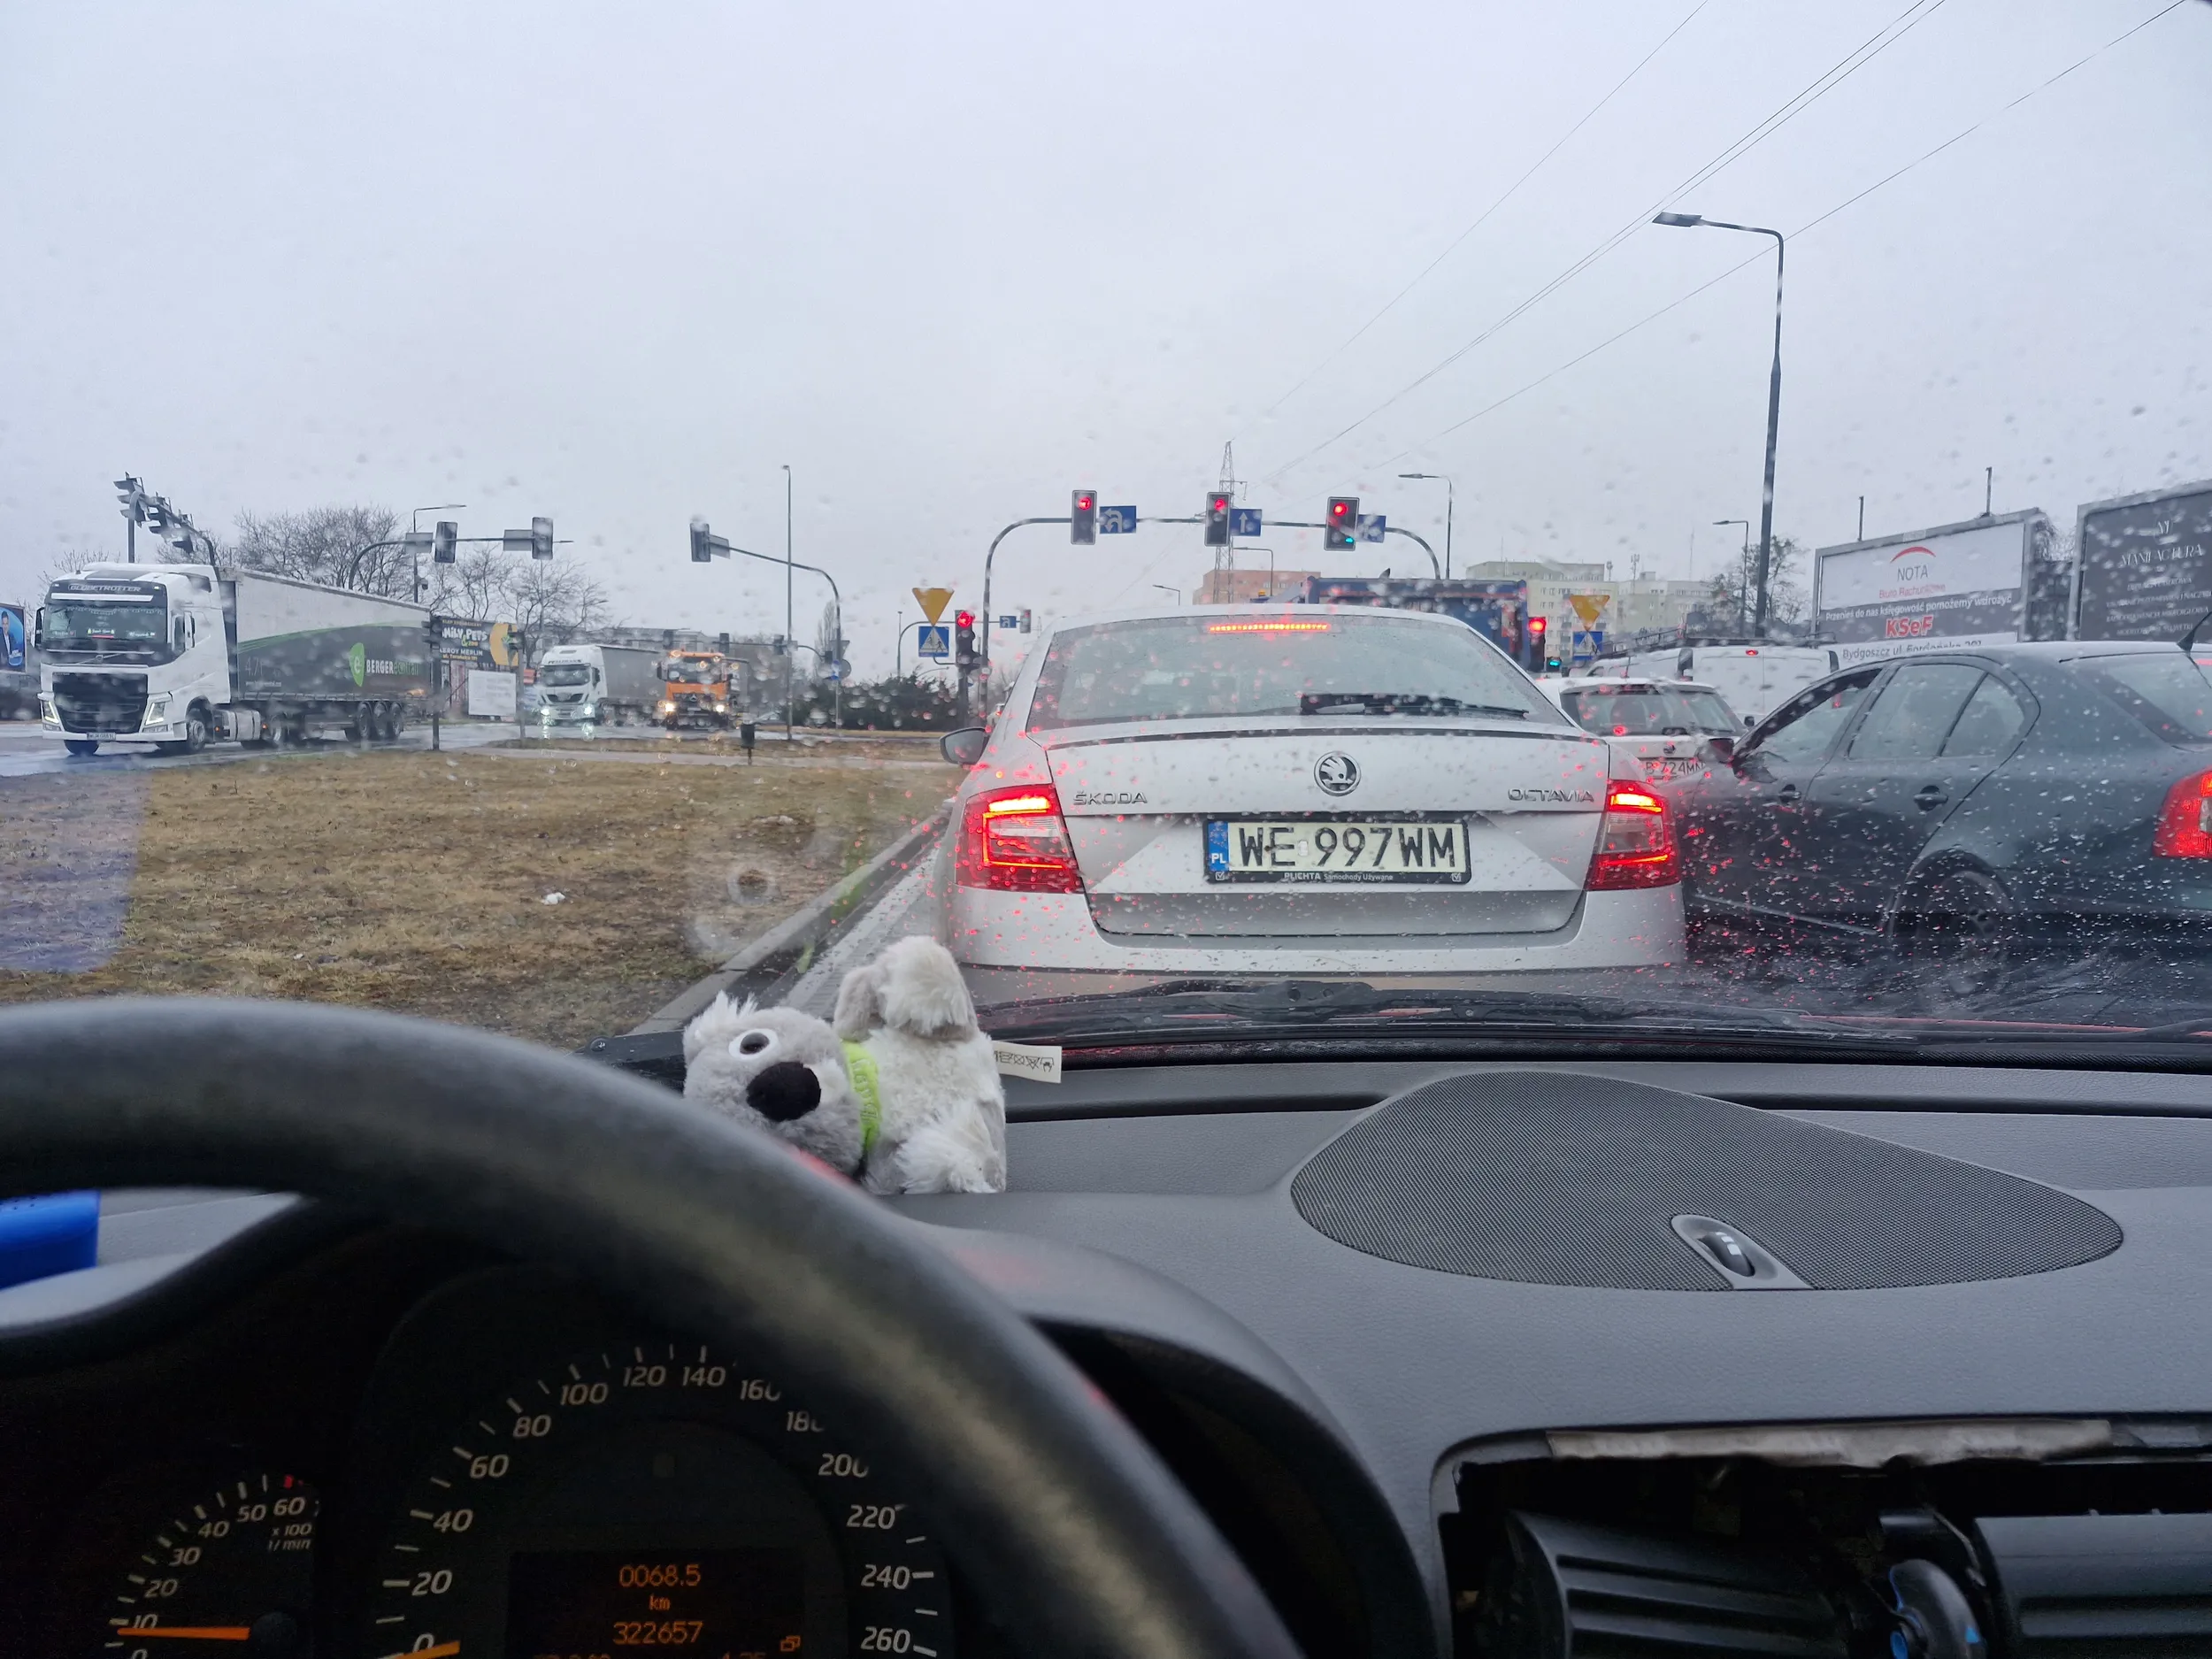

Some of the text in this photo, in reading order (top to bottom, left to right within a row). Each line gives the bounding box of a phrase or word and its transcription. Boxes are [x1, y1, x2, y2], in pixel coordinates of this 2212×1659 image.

[1897, 565, 1929, 582] NOTA
[1825, 610, 1855, 621] Przenieś
[1855, 609, 1864, 618] do
[1880, 602, 1924, 617] księgowość
[1925, 598, 1973, 612] pomożemy
[466, 629, 488, 641] PETS
[1886, 614, 1933, 638] KSeF
[1843, 648, 1890, 660] Bydgoszcz
[1073, 790, 1148, 805] ŠKODA
[1508, 788, 1594, 803] OCTAVIA
[1239, 827, 1455, 868] WE 997WM
[1210, 853, 1226, 864] PL
[1284, 872, 1321, 880] PLICHTA
[623, 1366, 667, 1387] 120
[682, 1366, 726, 1387] 140
[560, 1383, 609, 1405] 100
[513, 1415, 551, 1439] 80
[470, 1454, 510, 1479] 60
[237, 1504, 266, 1523] 50
[273, 1496, 305, 1516] 60
[434, 1509, 473, 1532] 40
[846, 1504, 895, 1530] 220
[198, 1521, 229, 1538] 40
[284, 1523, 312, 1536] 100
[169, 1547, 201, 1567] 30
[411, 1570, 452, 1596] 20
[620, 1563, 702, 1587] 0068.5
[860, 1564, 910, 1590] 240
[144, 1578, 177, 1598] 20
[649, 1594, 671, 1611] km
[133, 1613, 157, 1629] 10
[613, 1621, 703, 1646] 322657
[860, 1626, 911, 1654] 260
